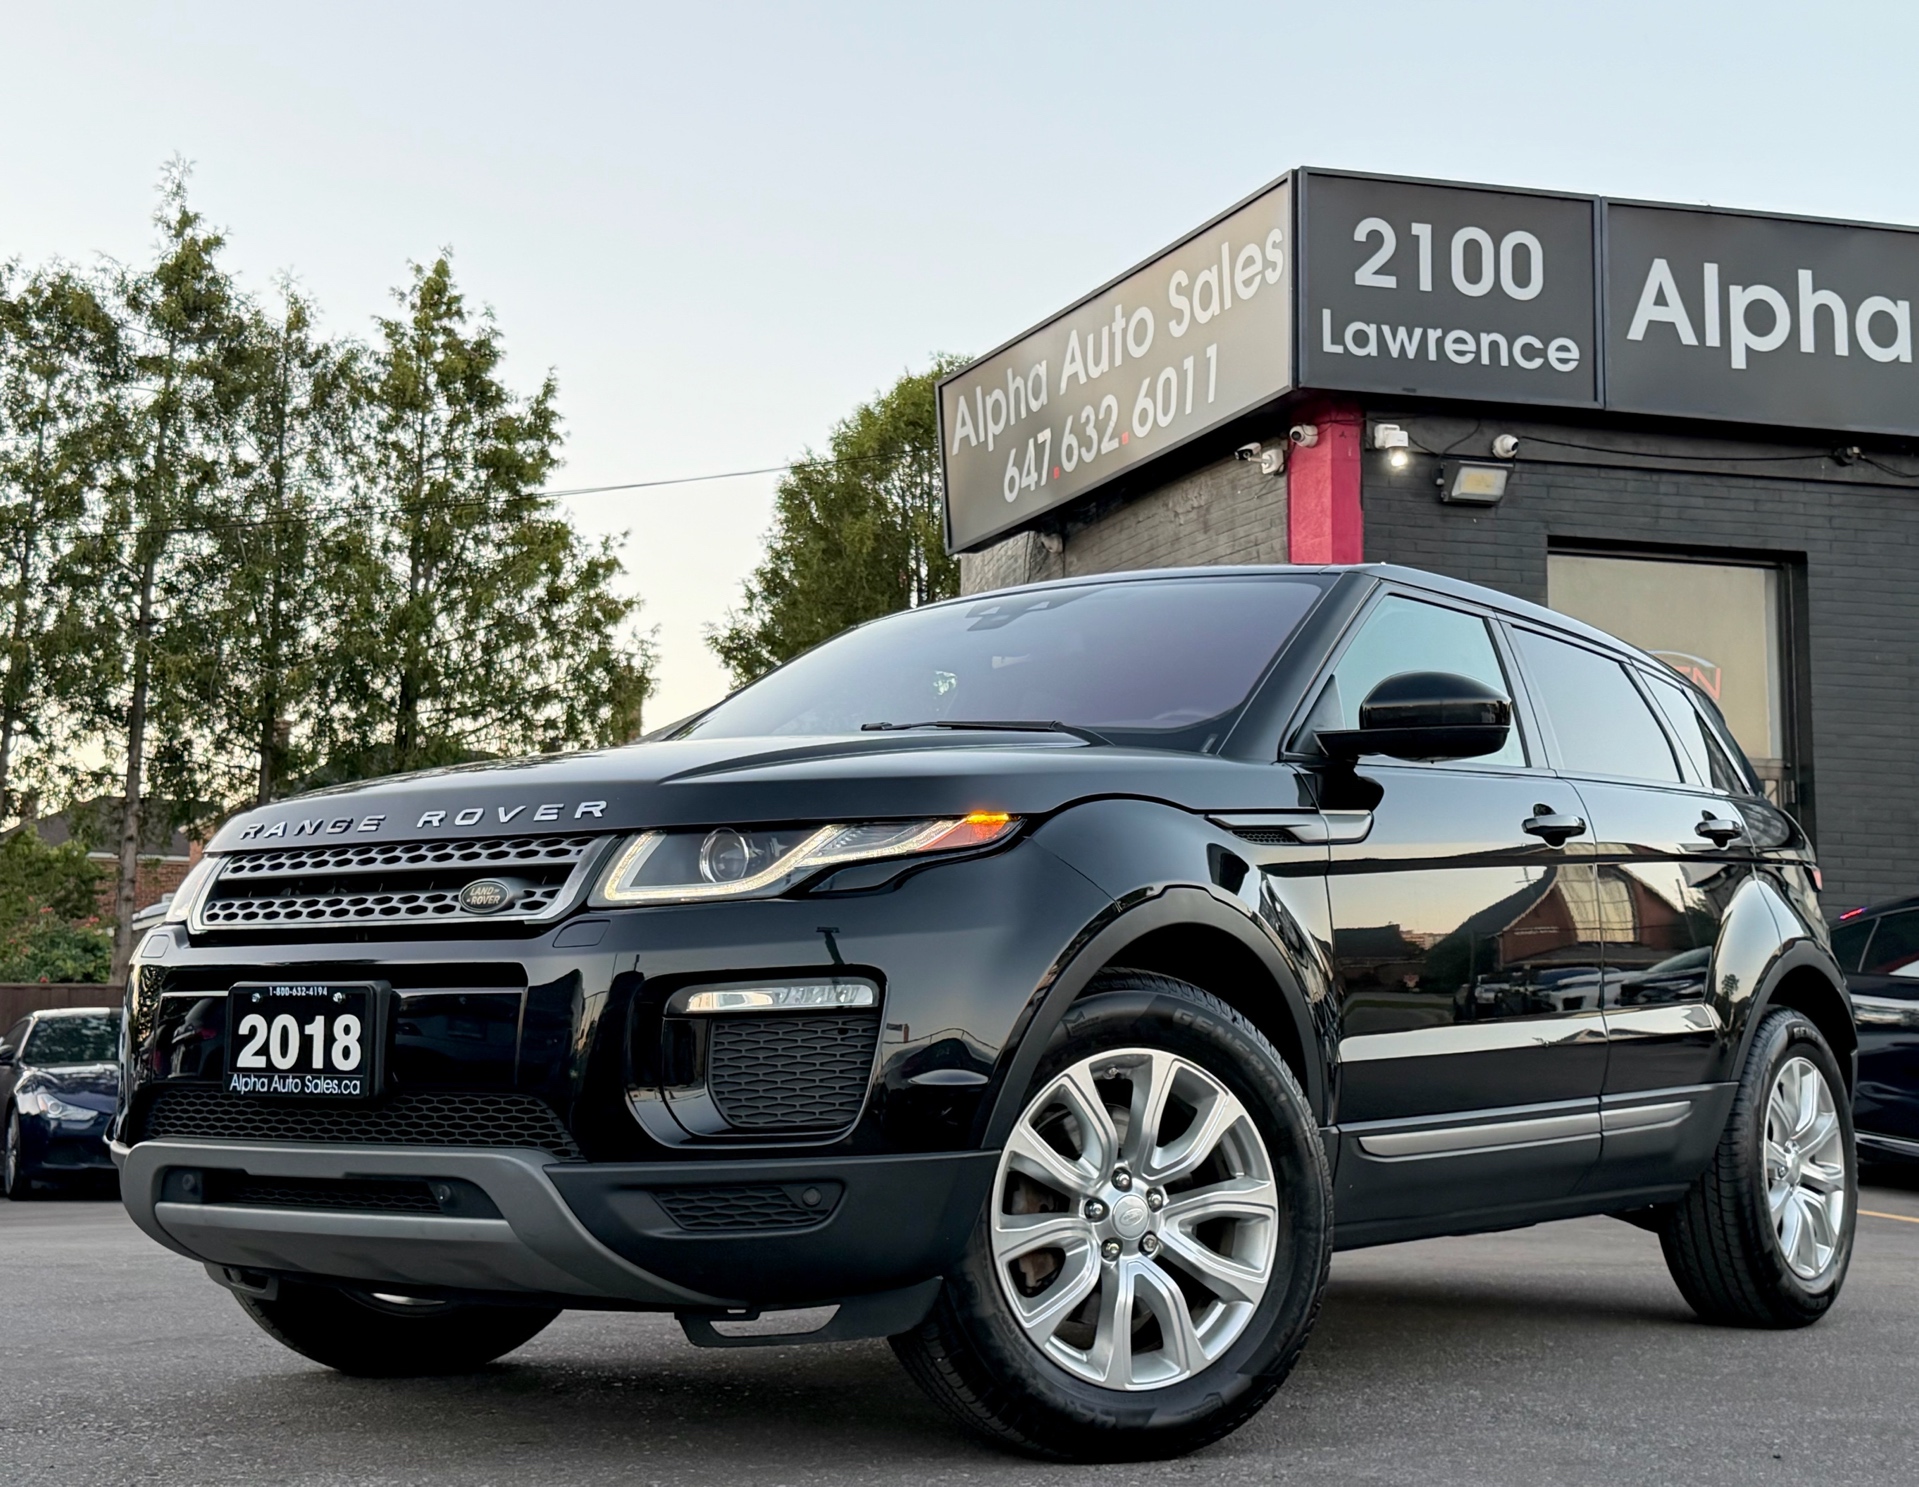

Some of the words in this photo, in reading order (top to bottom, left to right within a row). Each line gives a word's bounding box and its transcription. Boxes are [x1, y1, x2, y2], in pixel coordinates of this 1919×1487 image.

[1352, 216, 1545, 301] 2100
[951, 359, 1048, 456] Alpha
[1059, 303, 1155, 396] Auto
[1167, 228, 1285, 338] Sales
[1321, 307, 1581, 373] Lawrence
[1626, 257, 1914, 370] Alpha
[1003, 343, 1218, 503] 647.632.6011
[239, 813, 386, 841] RANGE
[416, 799, 608, 830] ROVER
[268, 986, 328, 997] 1-800-632-4194
[236, 1013, 362, 1071] 2018
[229, 1073, 268, 1095] Alpha
[270, 1074, 302, 1093] Auto
[304, 1075, 361, 1095] Sales.ca
